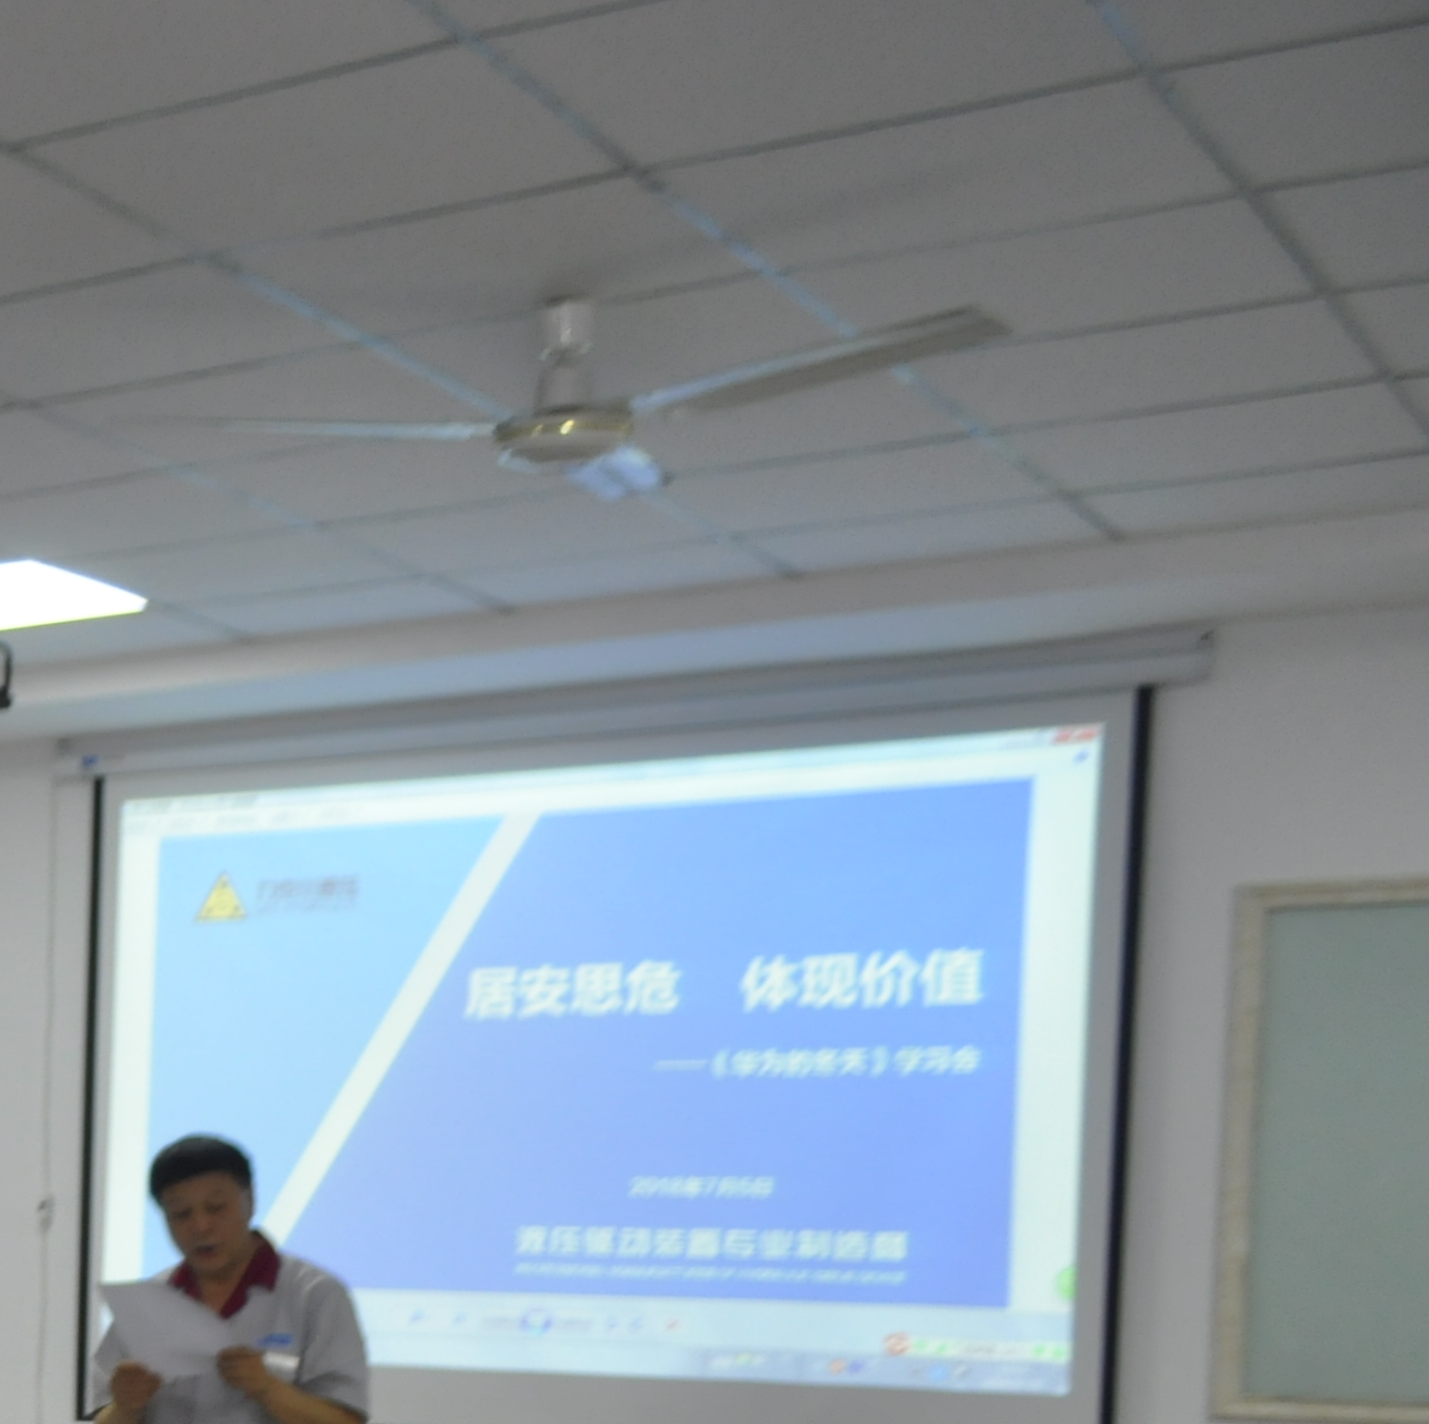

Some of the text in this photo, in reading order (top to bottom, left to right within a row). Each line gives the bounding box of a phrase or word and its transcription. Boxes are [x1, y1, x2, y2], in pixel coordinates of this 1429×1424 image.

[465, 949, 983, 1018] 居安思危 体现价值
